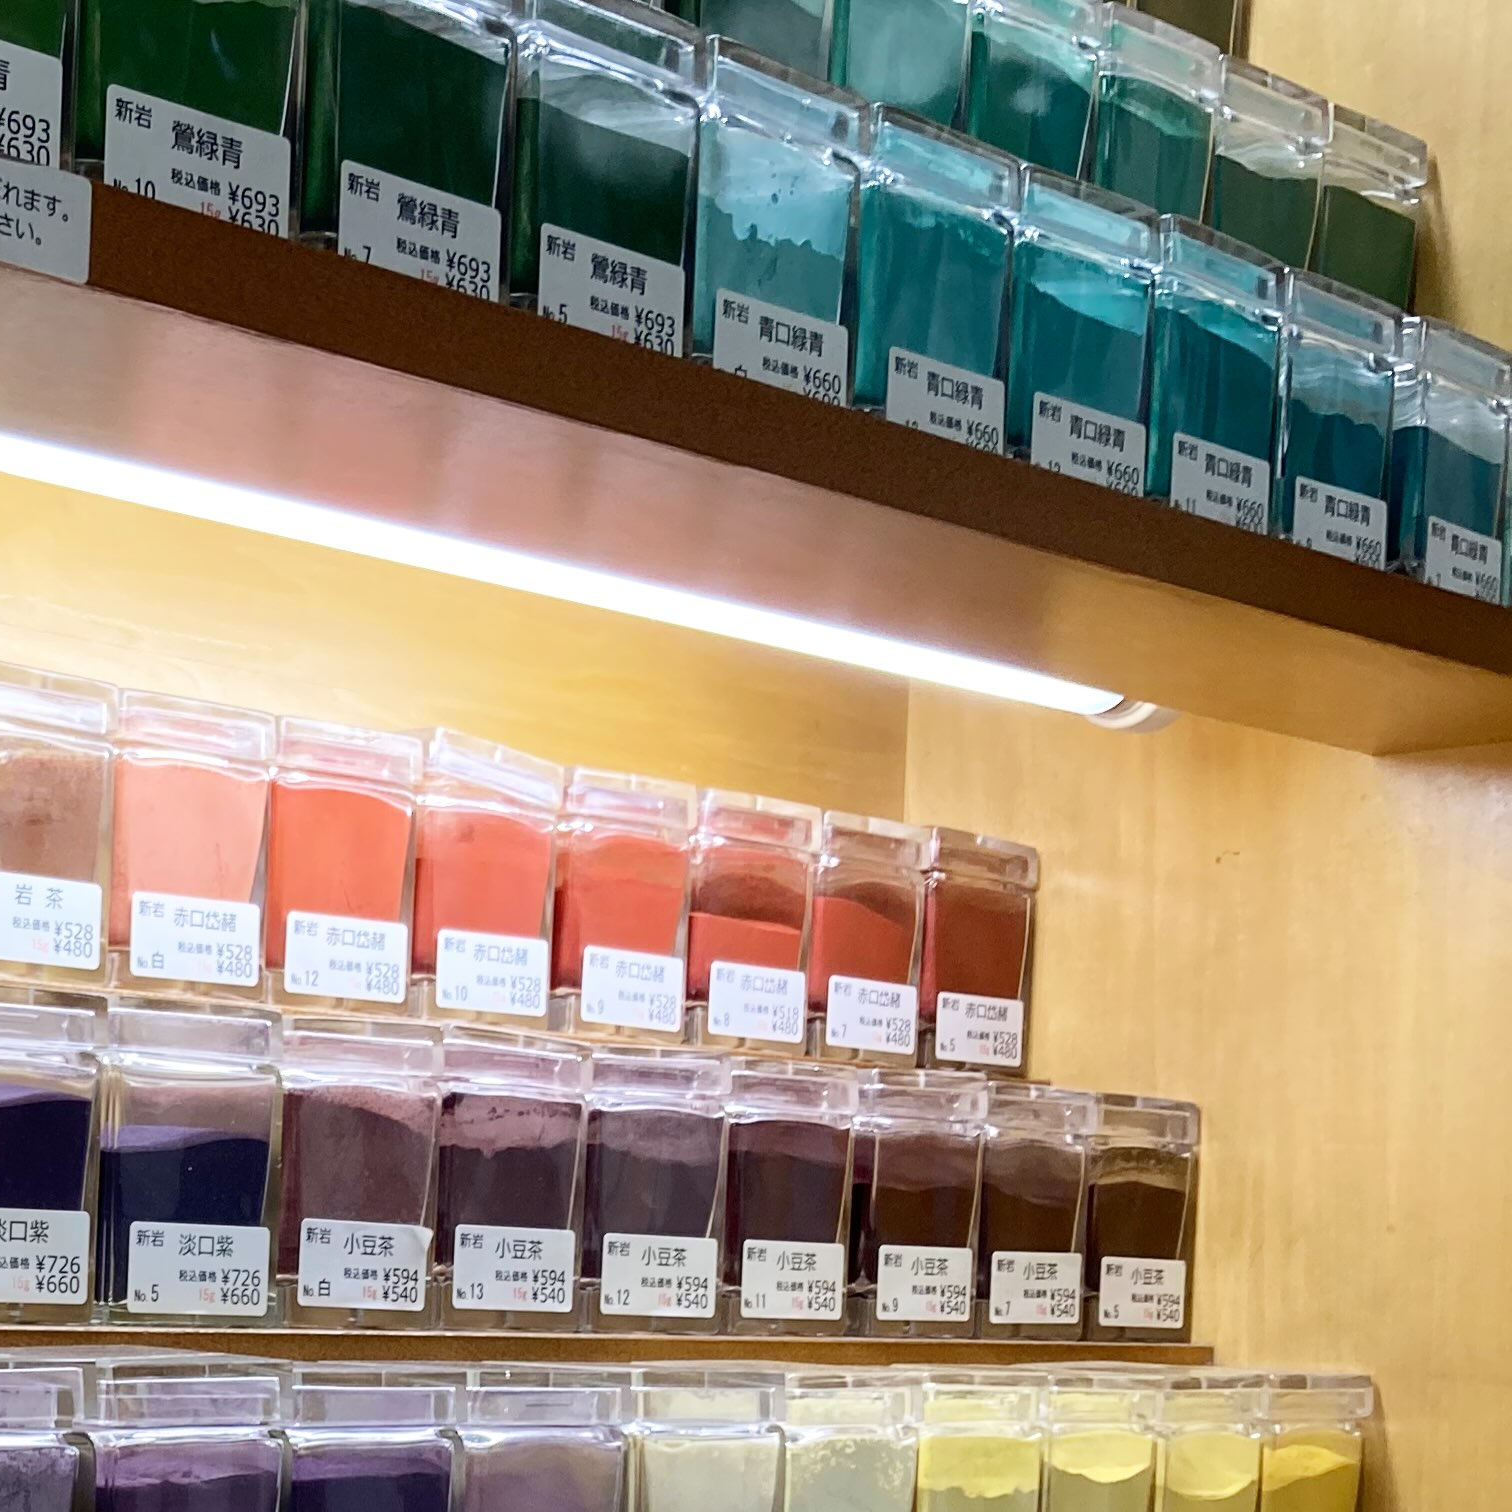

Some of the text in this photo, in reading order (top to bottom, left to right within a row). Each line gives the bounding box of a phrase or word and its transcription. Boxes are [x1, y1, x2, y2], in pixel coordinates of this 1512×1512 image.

[114, 97, 153, 129] 新岩
[171, 168, 280, 218] 税込価格 ¥693
[347, 172, 381, 202] 新岩
[546, 234, 576, 262] 新岩
[445, 248, 491, 283] ¥693
[634, 305, 675, 338] ¥693
[722, 298, 750, 325] 新岩
[803, 364, 841, 395] ¥660
[52, 919, 94, 946] ¥528
[305, 1225, 394, 1257] 新岩 小豆茶
[35, 1254, 80, 1279] ¥726
[384, 1267, 419, 1289] ¥594
[382, 1285, 418, 1303] ¥540
[676, 1275, 708, 1292] ¥594
